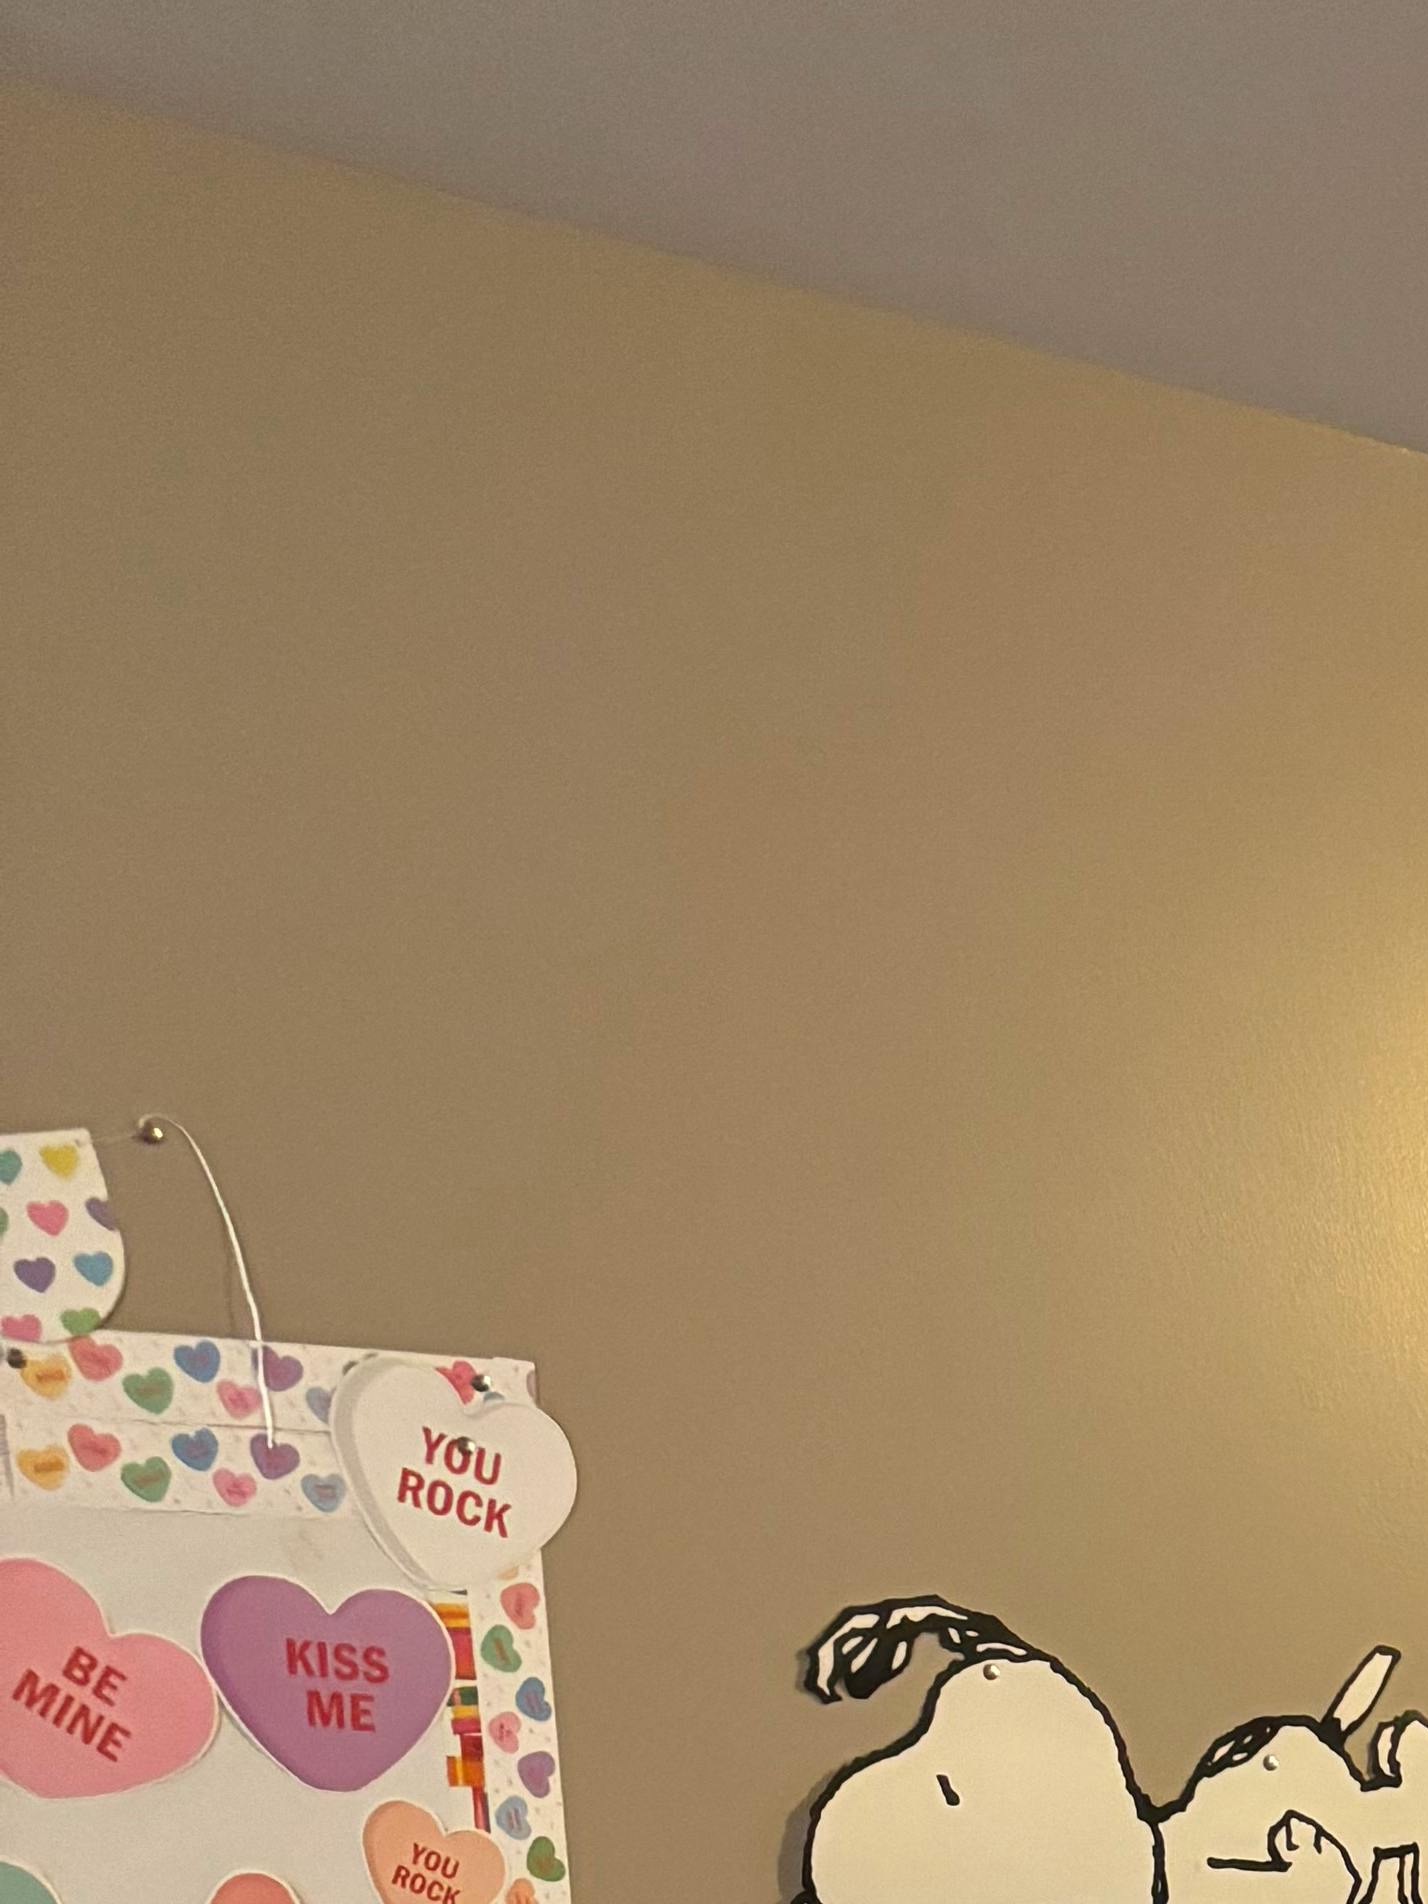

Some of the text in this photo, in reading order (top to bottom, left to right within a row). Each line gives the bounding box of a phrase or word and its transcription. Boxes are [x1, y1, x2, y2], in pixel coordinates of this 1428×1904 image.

[419, 1425, 502, 1487] YOU
[397, 1467, 513, 1539] ROCK
[61, 1645, 128, 1707] BE
[285, 1638, 390, 1684] KISS
[11, 1667, 133, 1764] MINE
[306, 1692, 377, 1732] ME
[410, 1841, 459, 1881] YOU
